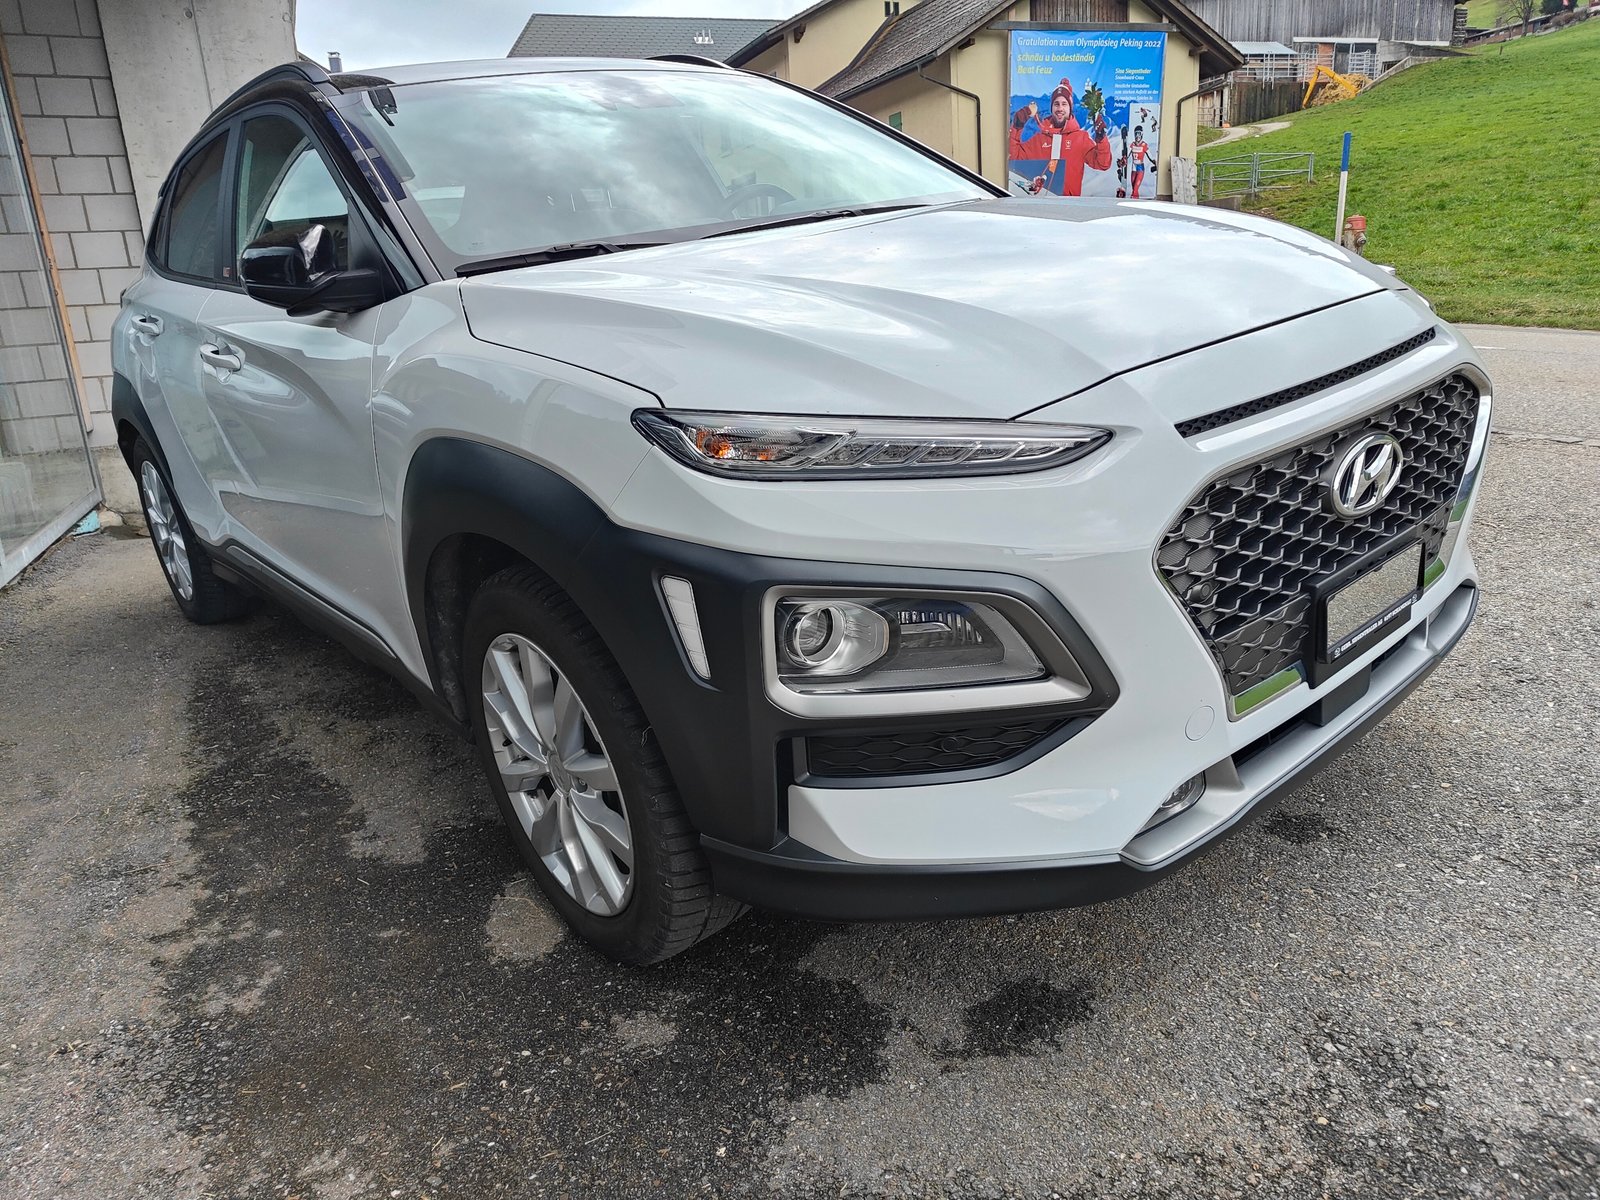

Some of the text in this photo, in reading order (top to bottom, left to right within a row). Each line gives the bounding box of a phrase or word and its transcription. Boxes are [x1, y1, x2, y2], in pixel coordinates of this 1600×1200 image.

[1017, 37, 1058, 46] Gratulation
[1076, 37, 1119, 49] Olympiasieg
[1119, 38, 1143, 49] Peking
[1051, 53, 1095, 64] bodeständig
[1017, 65, 1053, 74] Beat Feuz
